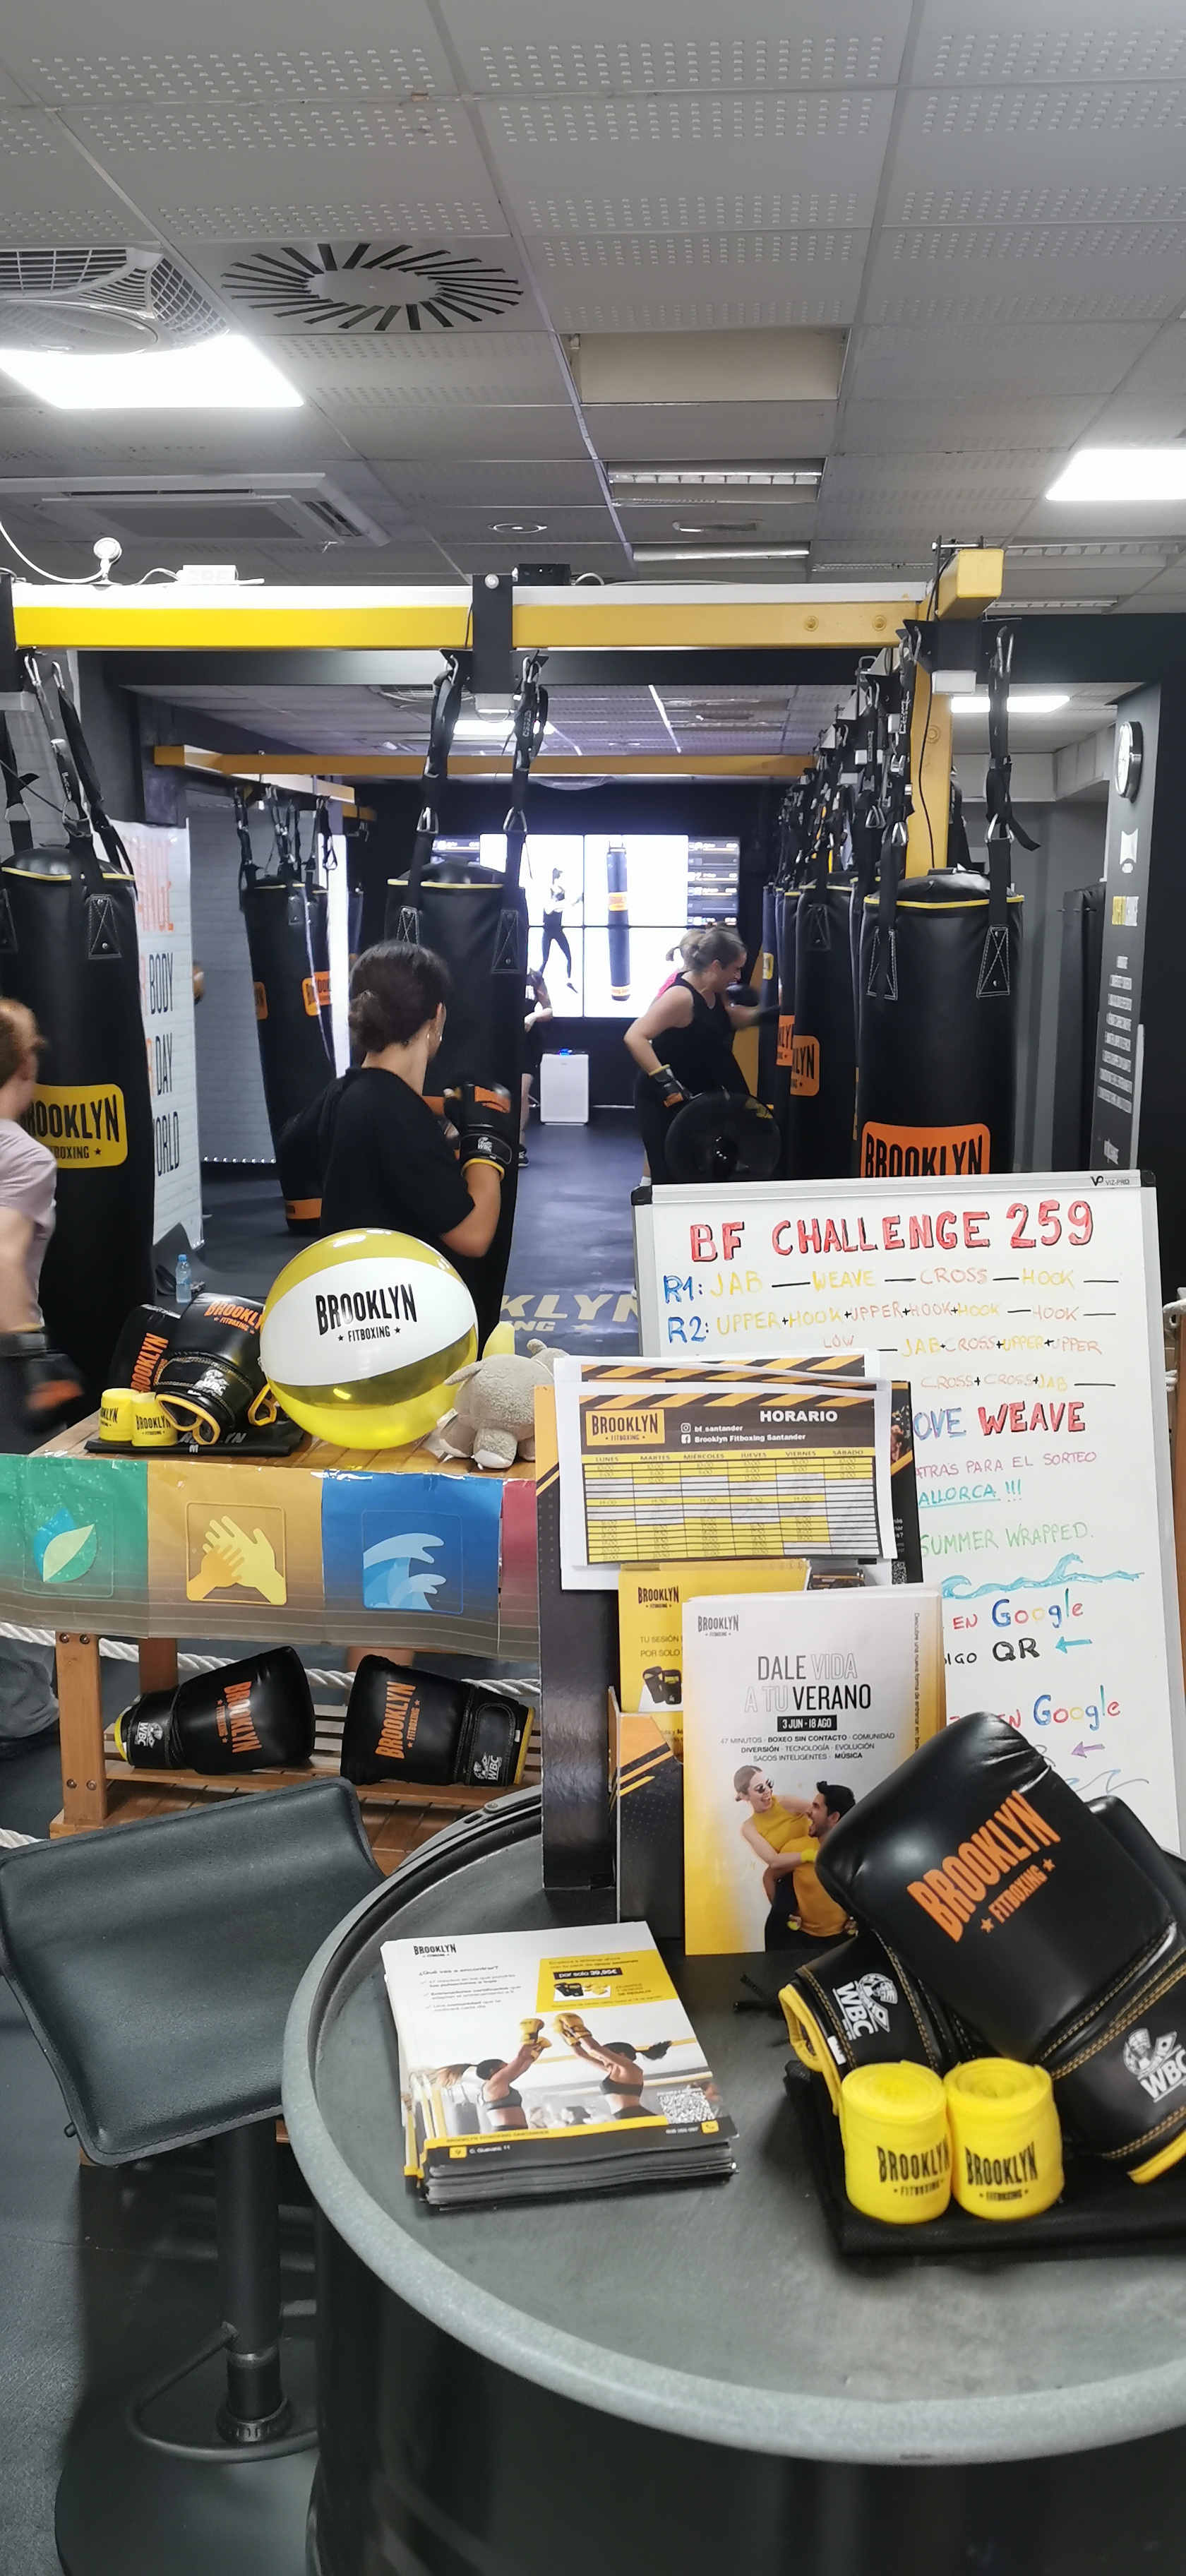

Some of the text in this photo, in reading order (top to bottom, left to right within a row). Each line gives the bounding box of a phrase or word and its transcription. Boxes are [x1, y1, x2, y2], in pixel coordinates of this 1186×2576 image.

[148, 953, 174, 1015] BODY
[155, 1032, 173, 1096] DAY
[1106, 1176, 1130, 1186] VIZ-PRO
[689, 1200, 1094, 1263] BF CHALLENGE 259
[709, 1271, 764, 1297] JAB
[811, 1270, 877, 1292] WEAVE
[920, 1268, 988, 1285] CROSS
[1022, 1268, 1076, 1289] HOOK
[316, 1283, 418, 1336] BROOKLYN
[1033, 1305, 1080, 1322] HOOK
[347, 1328, 390, 1342] FITBOXING
[822, 1334, 855, 1349] LOW
[202, 1378, 227, 1397] WBC
[592, 1410, 838, 1436] BROOKLYN HORARIO
[978, 1401, 1086, 1436] WEAVE
[694, 1433, 807, 1444] Brooklyn Fitboxing Santander
[966, 1459, 1004, 1474] PARA
[1012, 1455, 1034, 1468] EL
[1043, 1451, 1097, 1467] SORTEO
[920, 1528, 1000, 1558] SUMMER
[637, 1585, 679, 1604] BROOKLYN
[953, 1587, 1084, 1630] EN Google
[697, 1614, 740, 1633] BROOKLYN
[651, 1634, 680, 1644] SESIÓN
[992, 1638, 1041, 1662] QR
[757, 1652, 858, 1681] DALE VIDA
[744, 1683, 872, 1713] A TU VERANO
[1033, 1684, 1122, 1731] Google
[224, 1681, 263, 1754] BROOKLYN
[374, 1681, 417, 1760] BROOKLYN
[406, 1707, 421, 1741] FITBOXING
[782, 1717, 832, 1729] 3 JUN 18 AGO
[730, 1736, 763, 1744] MINUTOS
[808, 1734, 848, 1742] CONTACTO
[852, 1732, 896, 1741] COMUNIDAD
[741, 1741, 875, 1753] DIVERSIÓN TECNOLOGÍA EVOLUCIÓN
[487, 1755, 500, 1782] WBC
[834, 1751, 863, 1759] MÚSICA
[907, 1789, 1061, 1943] BROOKLYN
[990, 1864, 1048, 1925] FITBOXING
[413, 1943, 457, 1955] BROOKLYN
[836, 1981, 875, 2038] WBC
[1139, 2048, 1186, 2099] WBC
[877, 2133, 950, 2183] BROOKLYN
[964, 2140, 1038, 2186] BROOKLYN
